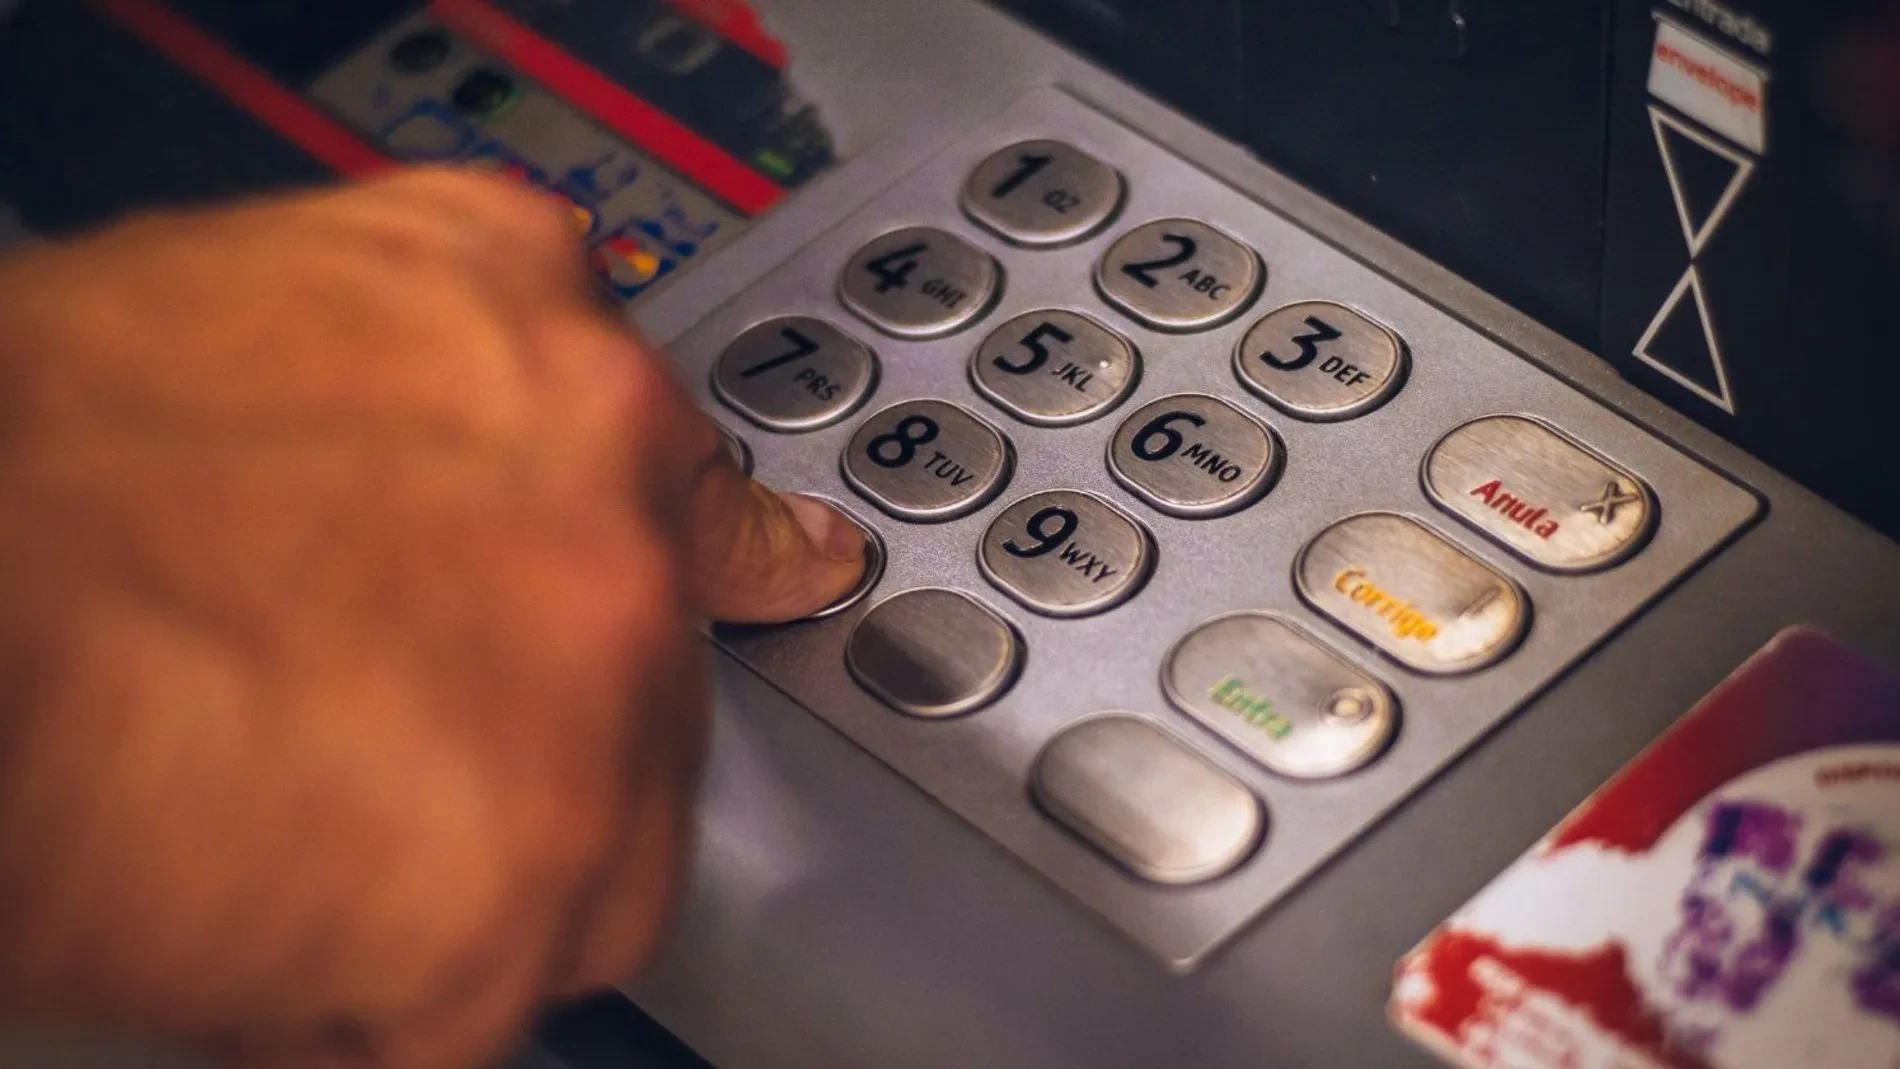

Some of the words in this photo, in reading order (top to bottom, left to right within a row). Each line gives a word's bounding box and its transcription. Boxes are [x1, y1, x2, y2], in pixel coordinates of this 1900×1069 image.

[991, 154, 1056, 199] 1
[865, 242, 929, 294] 4
[921, 279, 967, 309] GHI
[1121, 233, 1197, 289] 2
[1178, 269, 1231, 301] ABC
[740, 327, 821, 379] 7
[793, 367, 842, 401] PRS
[993, 322, 1075, 375] 5
[1051, 362, 1095, 393] JKL
[1259, 315, 1342, 371] 3
[1319, 356, 1371, 387] DEF
[867, 414, 940, 468] 8
[924, 452, 975, 487] TUV
[1131, 411, 1207, 462] 6
[1181, 443, 1242, 483] MNO
[1002, 506, 1079, 558] 9
[1059, 541, 1117, 583] WXY
[1470, 478, 1561, 541] Anula
[1334, 567, 1438, 642] Corrige
